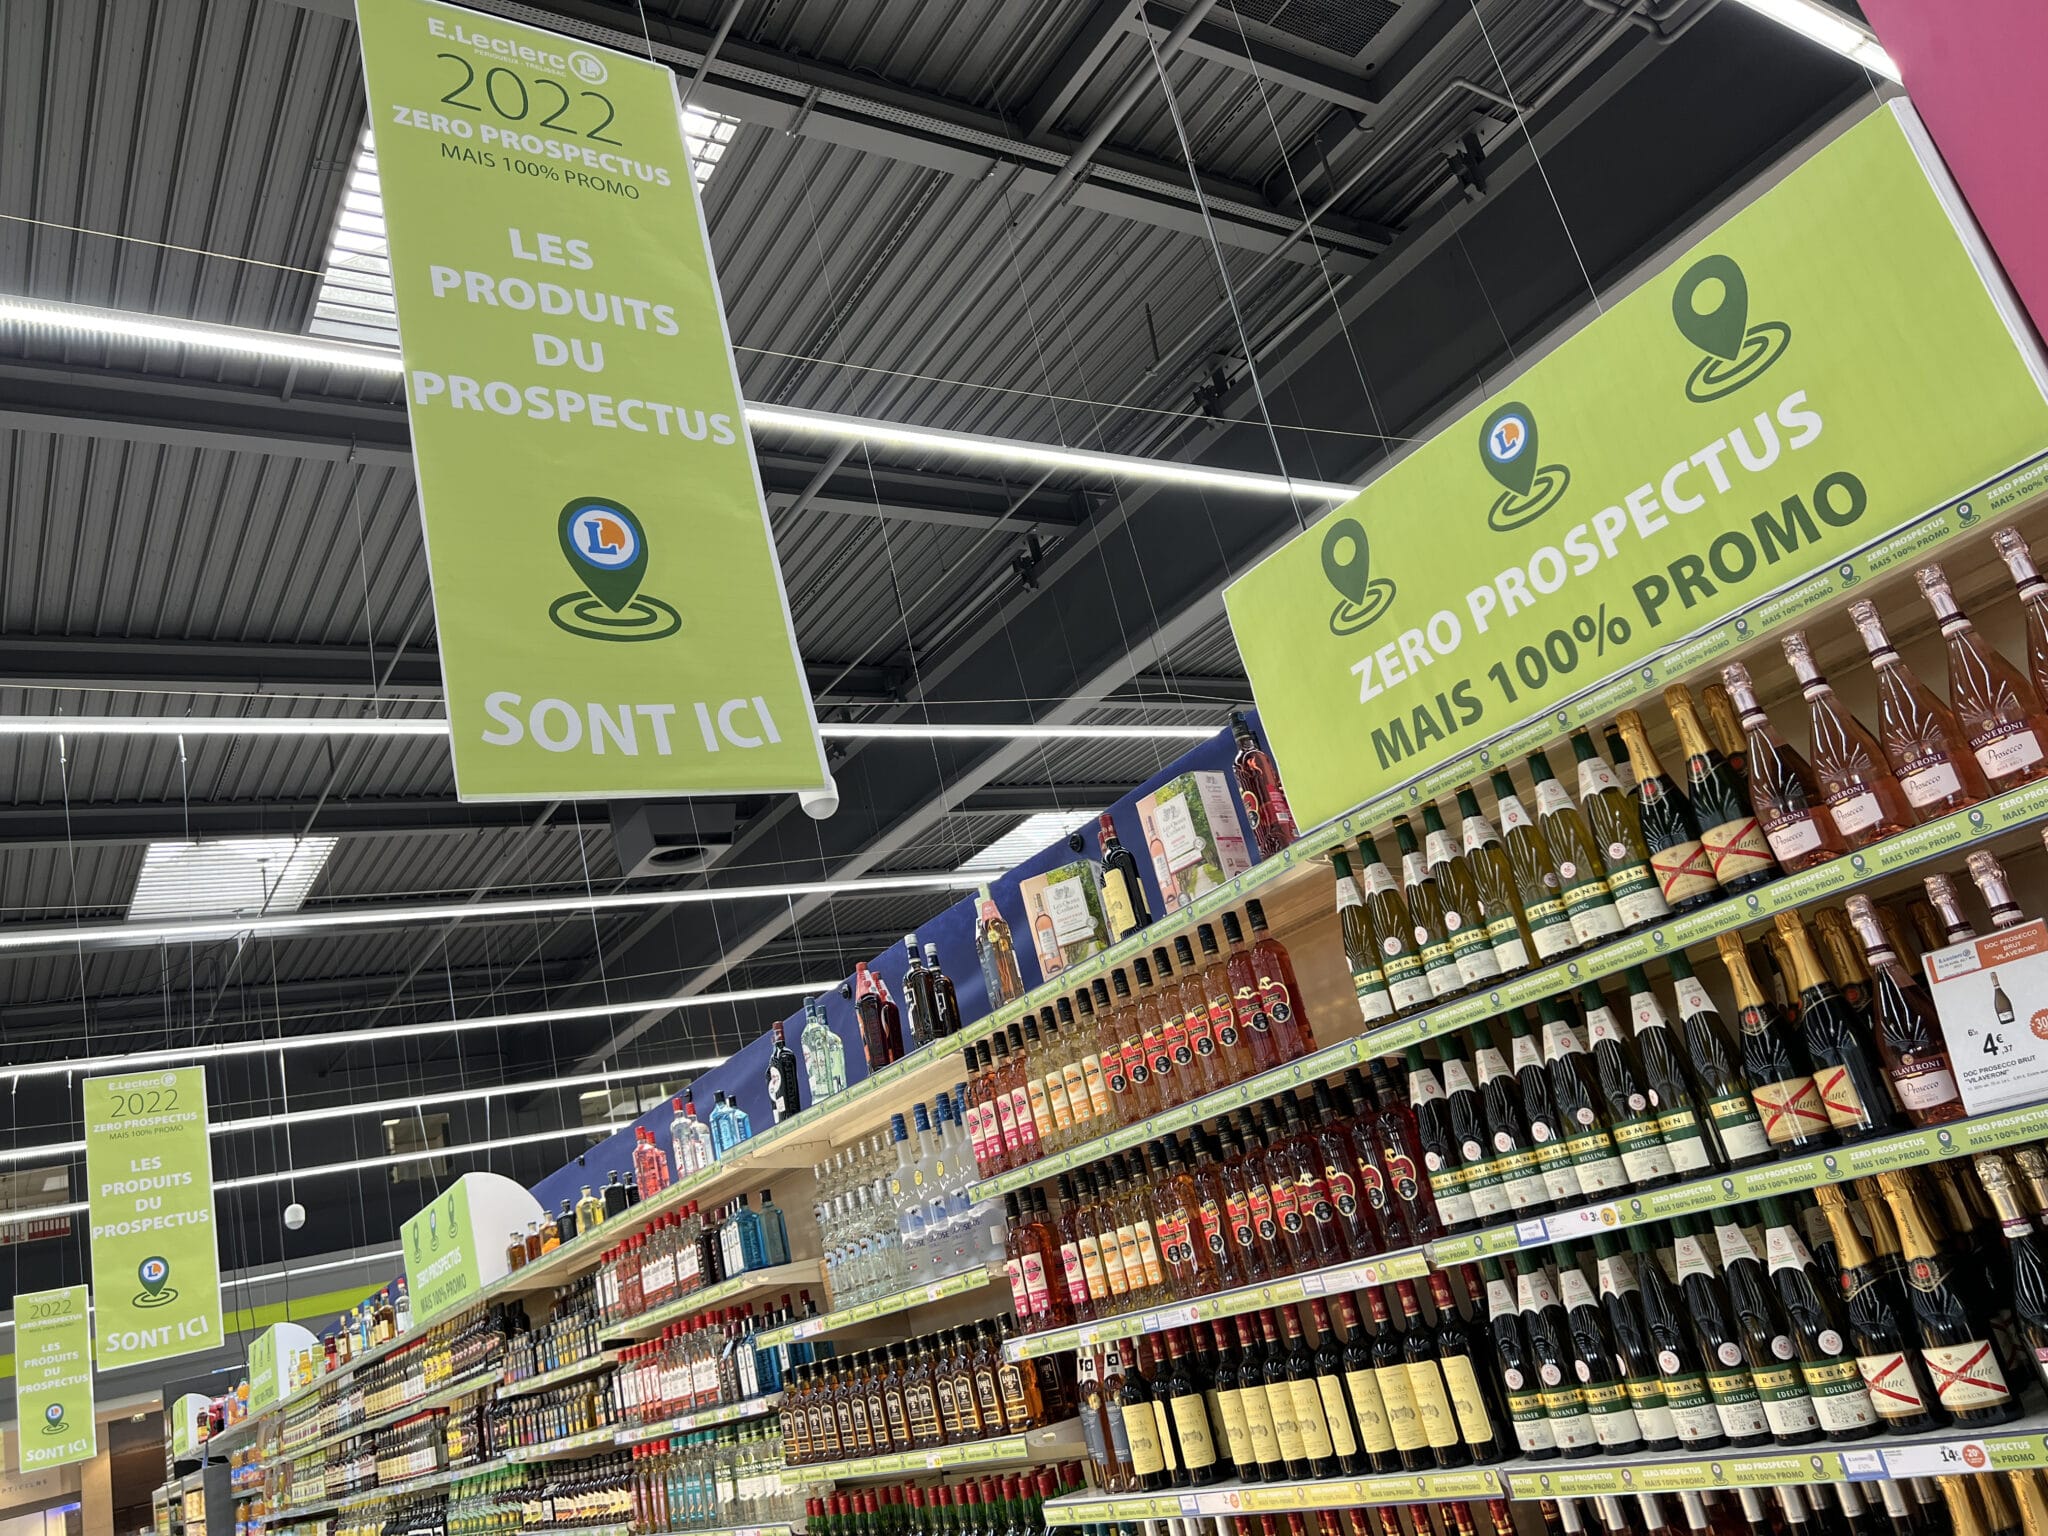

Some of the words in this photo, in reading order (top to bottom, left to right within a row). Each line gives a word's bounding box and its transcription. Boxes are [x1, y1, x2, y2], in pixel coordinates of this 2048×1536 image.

[428, 17, 565, 70] E.Leclerc
[436, 53, 623, 147] 2022
[392, 104, 474, 140] ZERO
[480, 124, 671, 188] PROSPECTUS
[441, 142, 496, 169] MAIS
[501, 155, 560, 183] 100%
[564, 169, 640, 201] PROMO
[508, 227, 595, 271] LES
[429, 264, 680, 337] PRODUITS
[532, 333, 605, 374] DU
[411, 369, 736, 447] PROSPECTUS
[1986, 482, 2012, 500] ZERO
[2012, 462, 2048, 487] PROSPE
[1990, 492, 2015, 510] MAIS
[2016, 479, 2043, 497] 100%
[1350, 609, 1463, 705] ZERO
[1465, 389, 1824, 635] PROSPECTUS
[1866, 545, 1890, 563] ZERO
[1889, 517, 1945, 551] PROSPECTUS
[1869, 555, 1893, 573] MAIS
[1891, 543, 1917, 561] 100%
[1915, 526, 1951, 549] PROMO
[1758, 601, 1780, 618] ZERO
[1778, 576, 1830, 608] PROSPECTUS
[1761, 610, 1783, 627] MAIS
[1780, 600, 1804, 618] 100%
[1802, 586, 1834, 607] PROMO
[1369, 678, 1484, 771] MAIS
[1487, 602, 1633, 702] 100%
[1631, 470, 1868, 629] PROMO
[1662, 652, 1682, 668] ZERO
[1680, 631, 1726, 659] PROSPECTUS
[1665, 661, 1685, 676] MAIS
[1683, 651, 1704, 668] 100%
[1702, 639, 1730, 658] PROMO
[481, 690, 676, 757] SONT
[694, 695, 782, 752] ICI
[1970, 720, 2024, 748] VILAVERONI
[1984, 742, 2024, 765] Prosecco
[1908, 774, 1941, 794] Prosecco
[1998, 796, 2023, 811] ZERO
[2002, 806, 2027, 822] MAIS
[1877, 840, 1902, 856] ZERO
[1900, 821, 1957, 848] PROSPECTUS
[1881, 851, 1904, 867] MAIS
[1902, 842, 1928, 859] 100%
[1927, 831, 1961, 850] PROMO
[1770, 882, 1791, 896] ZERO
[1790, 865, 1840, 889] PROSPECTUS
[1772, 892, 1794, 906] MAIS
[1792, 884, 1816, 899] 100%
[1814, 874, 1845, 891] PROMO
[1673, 920, 1693, 933] ZERO
[1691, 904, 1737, 927] PROSPECTUS
[1676, 929, 1696, 942] MAIS
[1694, 922, 1715, 936] 100%
[1713, 912, 1741, 929] PROMO
[1979, 1060, 2017, 1075] PROSECCO
[2017, 1054, 2036, 1066] BRUT
[1903, 1081, 1939, 1097] Prosecco
[110, 1088, 180, 1119] 2022
[92, 1121, 122, 1133] ZERO
[124, 1112, 198, 1129] PROSPECTUS
[109, 1131, 130, 1141] MAIS
[154, 1124, 184, 1135] PROMO
[1966, 1123, 1991, 1135] ZERO
[1990, 1109, 2048, 1130] PROSPECTUS
[1969, 1134, 1994, 1146] MAIS
[1994, 1128, 2020, 1141] 100%
[2020, 1122, 2048, 1135] PROM
[1849, 1149, 1872, 1161] ZERO
[1872, 1137, 1926, 1156] PROSPECTUS
[1852, 1159, 1875, 1171] MAIS
[1873, 1154, 1898, 1167] 100%
[1897, 1148, 1930, 1162] PROMO
[130, 1156, 162, 1173] LES
[1745, 1173, 1766, 1185] ZERO
[1765, 1162, 1813, 1180] PROSPECTUS
[101, 1172, 193, 1198] PRODUITS
[1651, 1194, 1670, 1204] ZERO
[1668, 1184, 1713, 1201] PROSPECTUS
[1748, 1182, 1768, 1193] MAIS
[1767, 1178, 1789, 1190] 100%
[1787, 1172, 1817, 1185] PROMO
[135, 1196, 162, 1213] DU
[1654, 1203, 1672, 1214] MAIS
[1670, 1199, 1691, 1210] 100%
[1689, 1194, 1717, 1206] PROMO
[92, 1209, 209, 1240] PROSPECTUS
[445, 1273, 467, 1299] PROMO
[29, 1299, 72, 1320] 2022
[106, 1325, 172, 1353] SONT
[177, 1315, 209, 1341] ICI
[23, 1350, 79, 1369] PRODUITS
[41, 1342, 61, 1354] LES
[18, 1373, 90, 1395] PROSPECTUS
[44, 1366, 61, 1377] DU
[26, 1445, 65, 1462] SONT
[68, 1438, 88, 1454] ICI
[1985, 1440, 2031, 1453] OSPECTUS
[2001, 1453, 2036, 1464] PROMO
[1642, 1468, 1660, 1477] ZERO
[1659, 1465, 1701, 1476] PROSPECTUS
[1733, 1462, 1754, 1471] ZERO
[1753, 1460, 1800, 1471] PROSPECTUS
[1736, 1472, 1756, 1481] MAIS
[1755, 1471, 1776, 1481] 100%
[1775, 1470, 1804, 1480] PROMO
[1644, 1478, 1662, 1486] MAIS
[1661, 1477, 1680, 1486] 100%
[1679, 1477, 1706, 1485] PROMO
